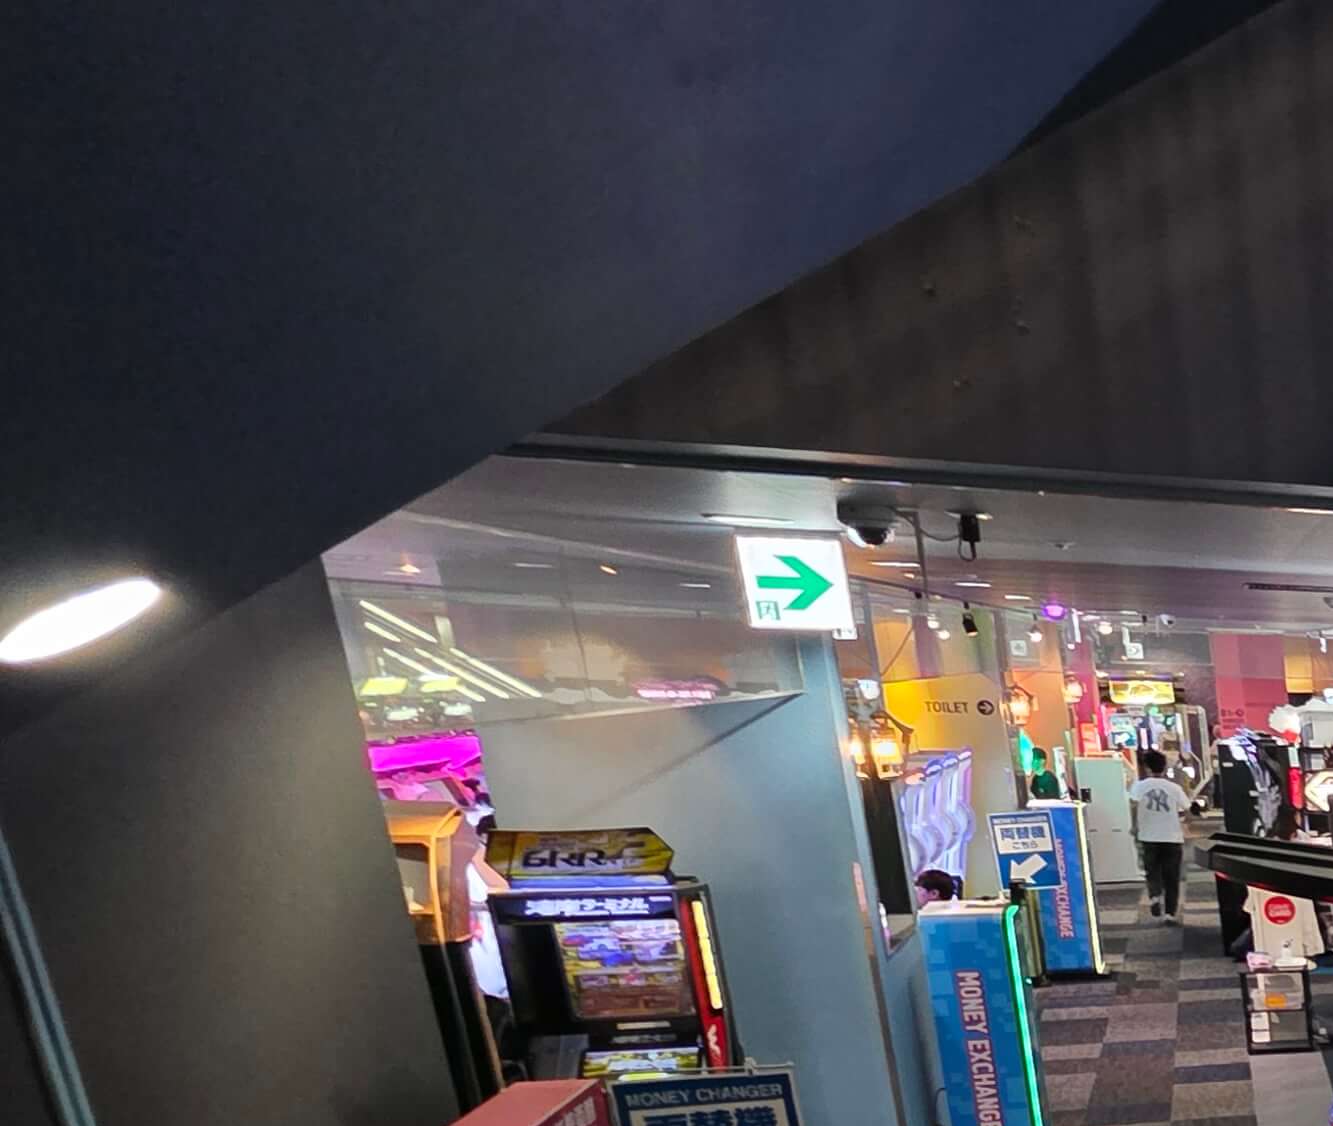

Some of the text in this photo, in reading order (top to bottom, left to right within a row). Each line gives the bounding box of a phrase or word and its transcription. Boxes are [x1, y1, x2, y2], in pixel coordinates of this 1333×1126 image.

[924, 701, 969, 714] TOILET
[955, 972, 989, 1034] MONEY
[624, 1083, 784, 1107] MONEY CHANGER
